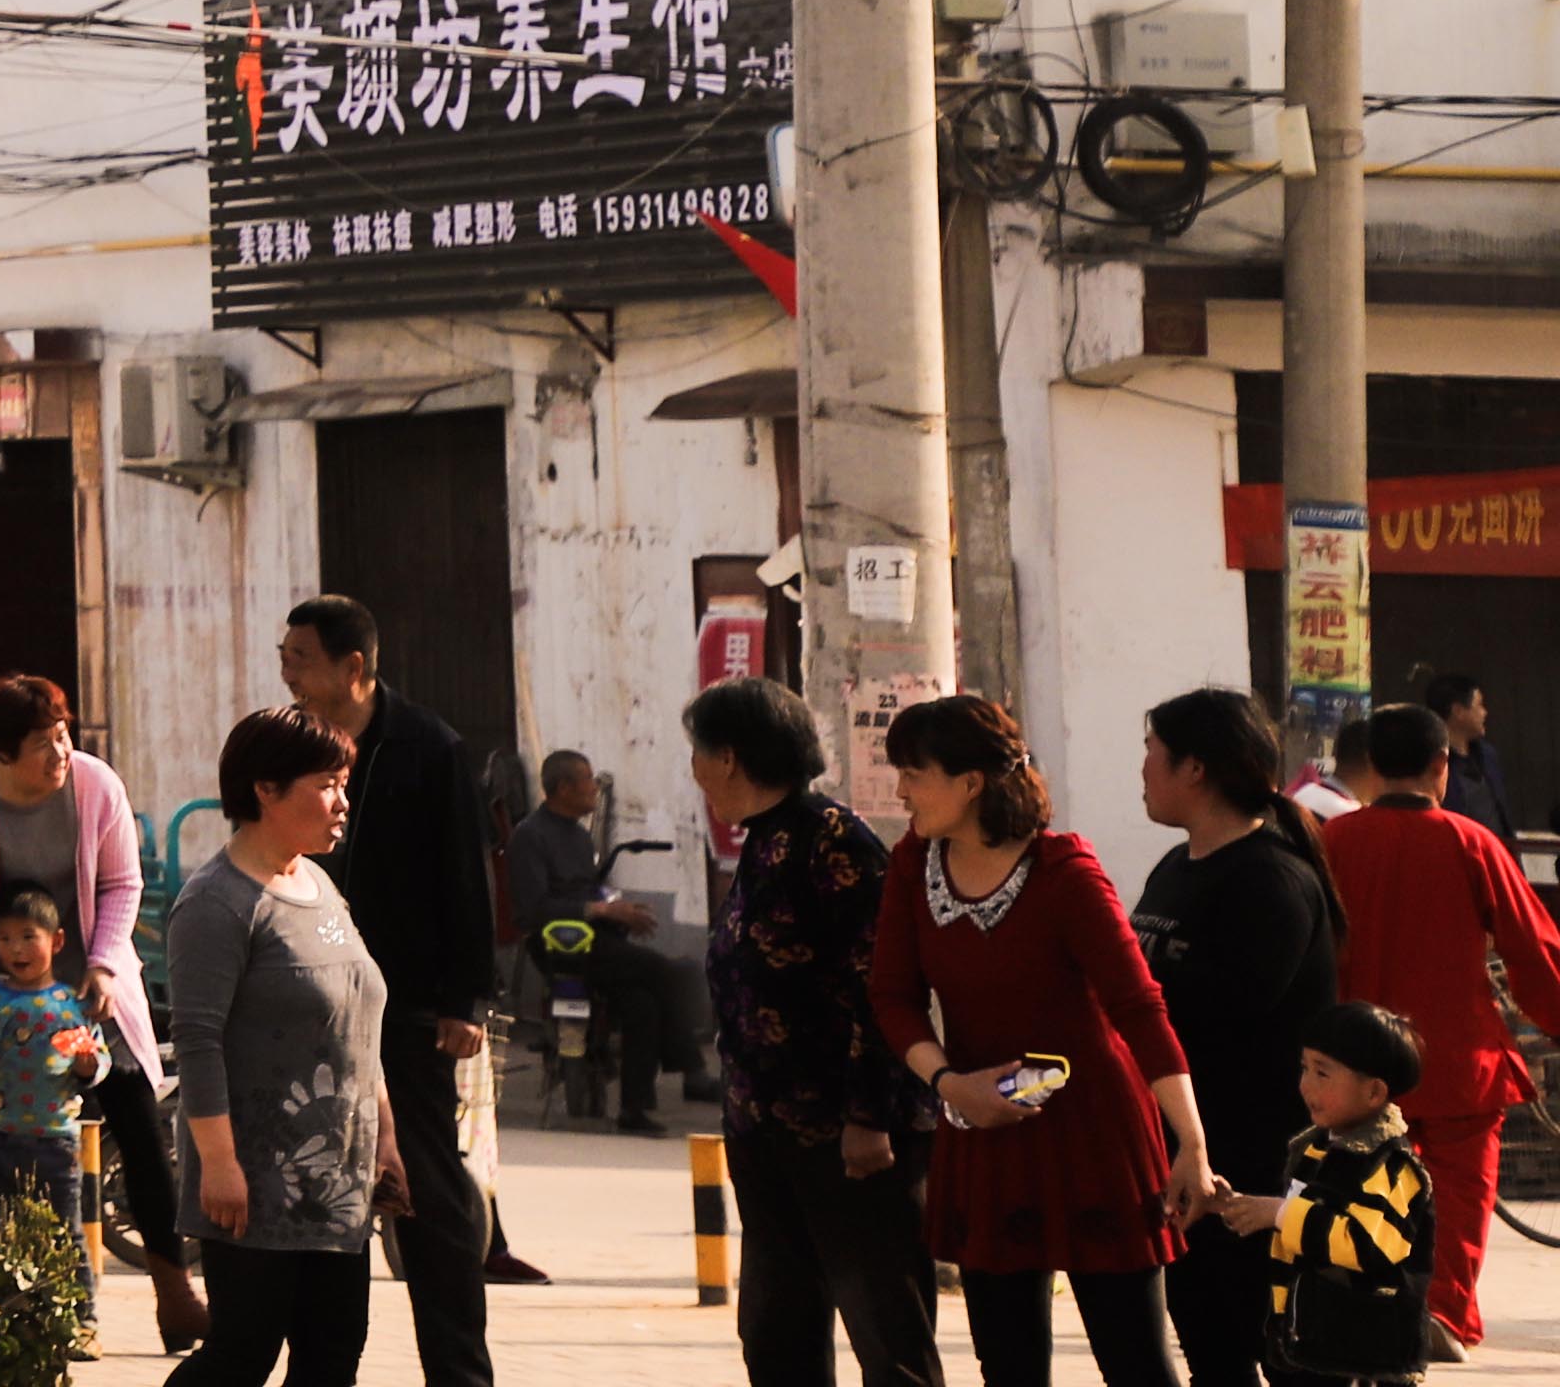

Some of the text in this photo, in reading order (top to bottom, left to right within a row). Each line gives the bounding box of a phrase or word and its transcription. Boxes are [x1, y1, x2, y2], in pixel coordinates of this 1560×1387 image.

[538, 193, 578, 239] 电话
[593, 183, 769, 233] 15931496828
[854, 558, 910, 581] 招工
